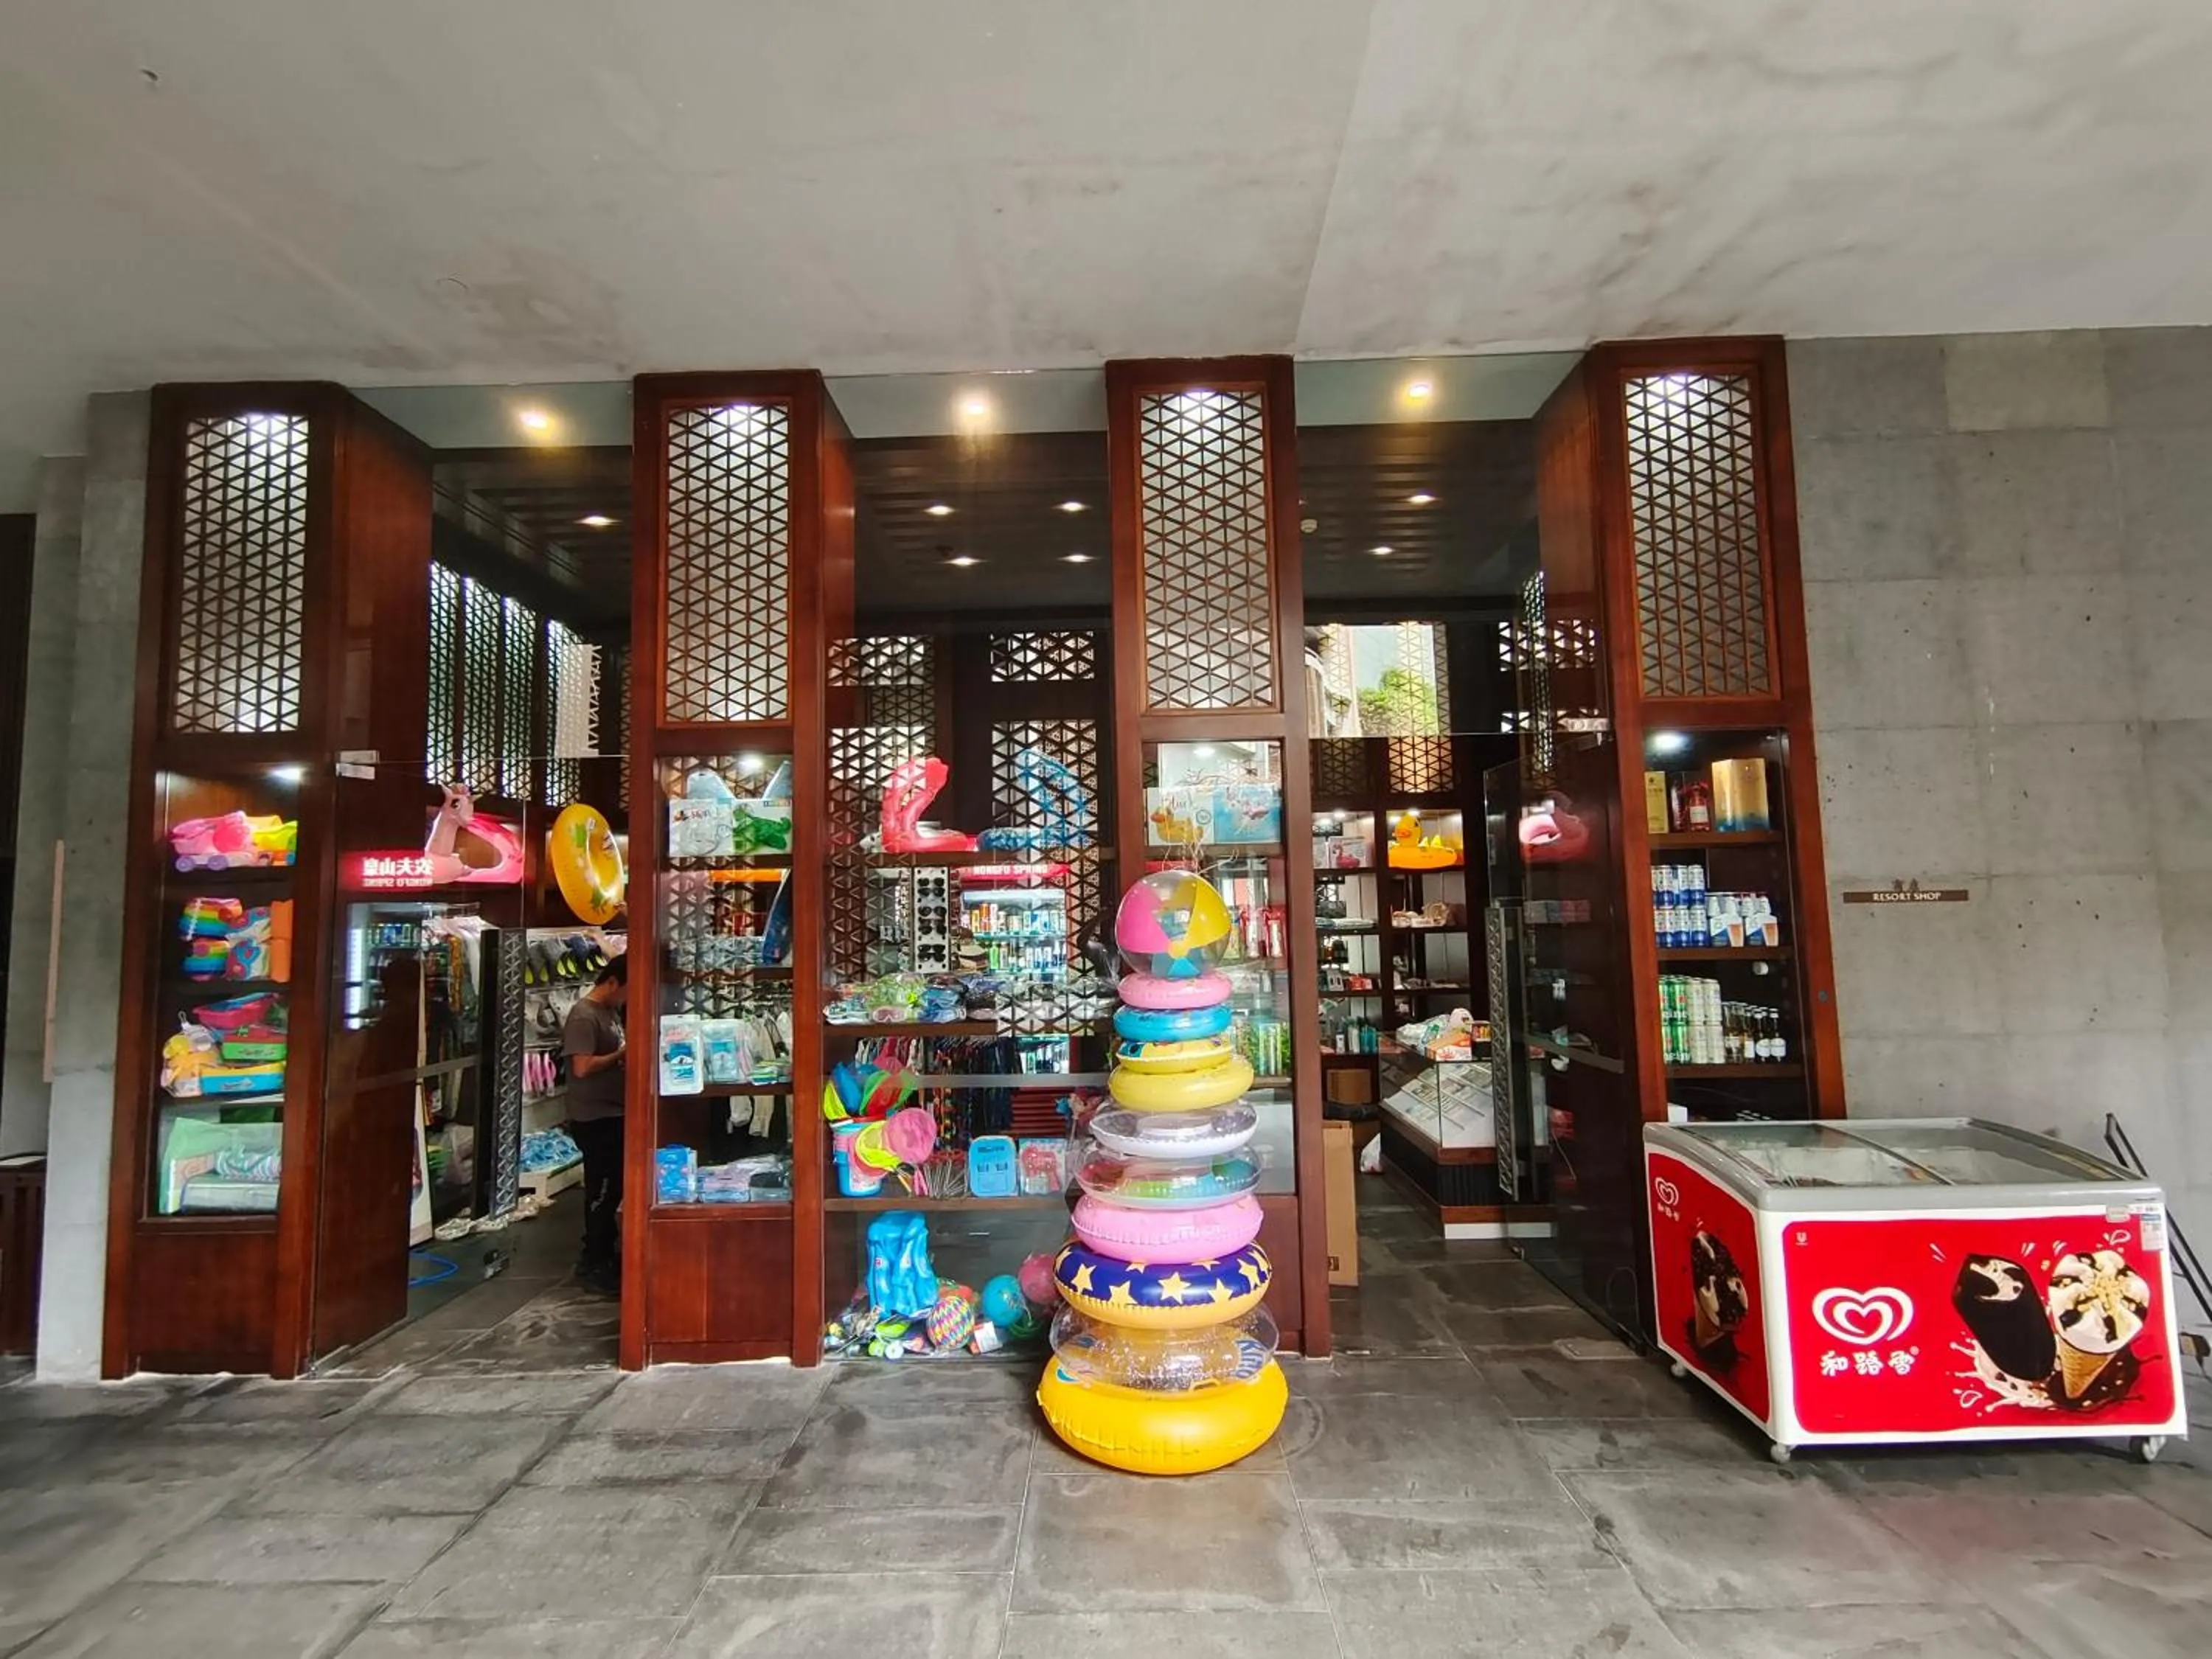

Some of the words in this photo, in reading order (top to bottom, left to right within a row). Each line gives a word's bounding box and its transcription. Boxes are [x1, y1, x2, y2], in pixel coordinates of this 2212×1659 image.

[1873, 893, 1911, 901] RESORT
[1913, 891, 1941, 900] SHOP
[1820, 1350, 1916, 1377] 和路雪
